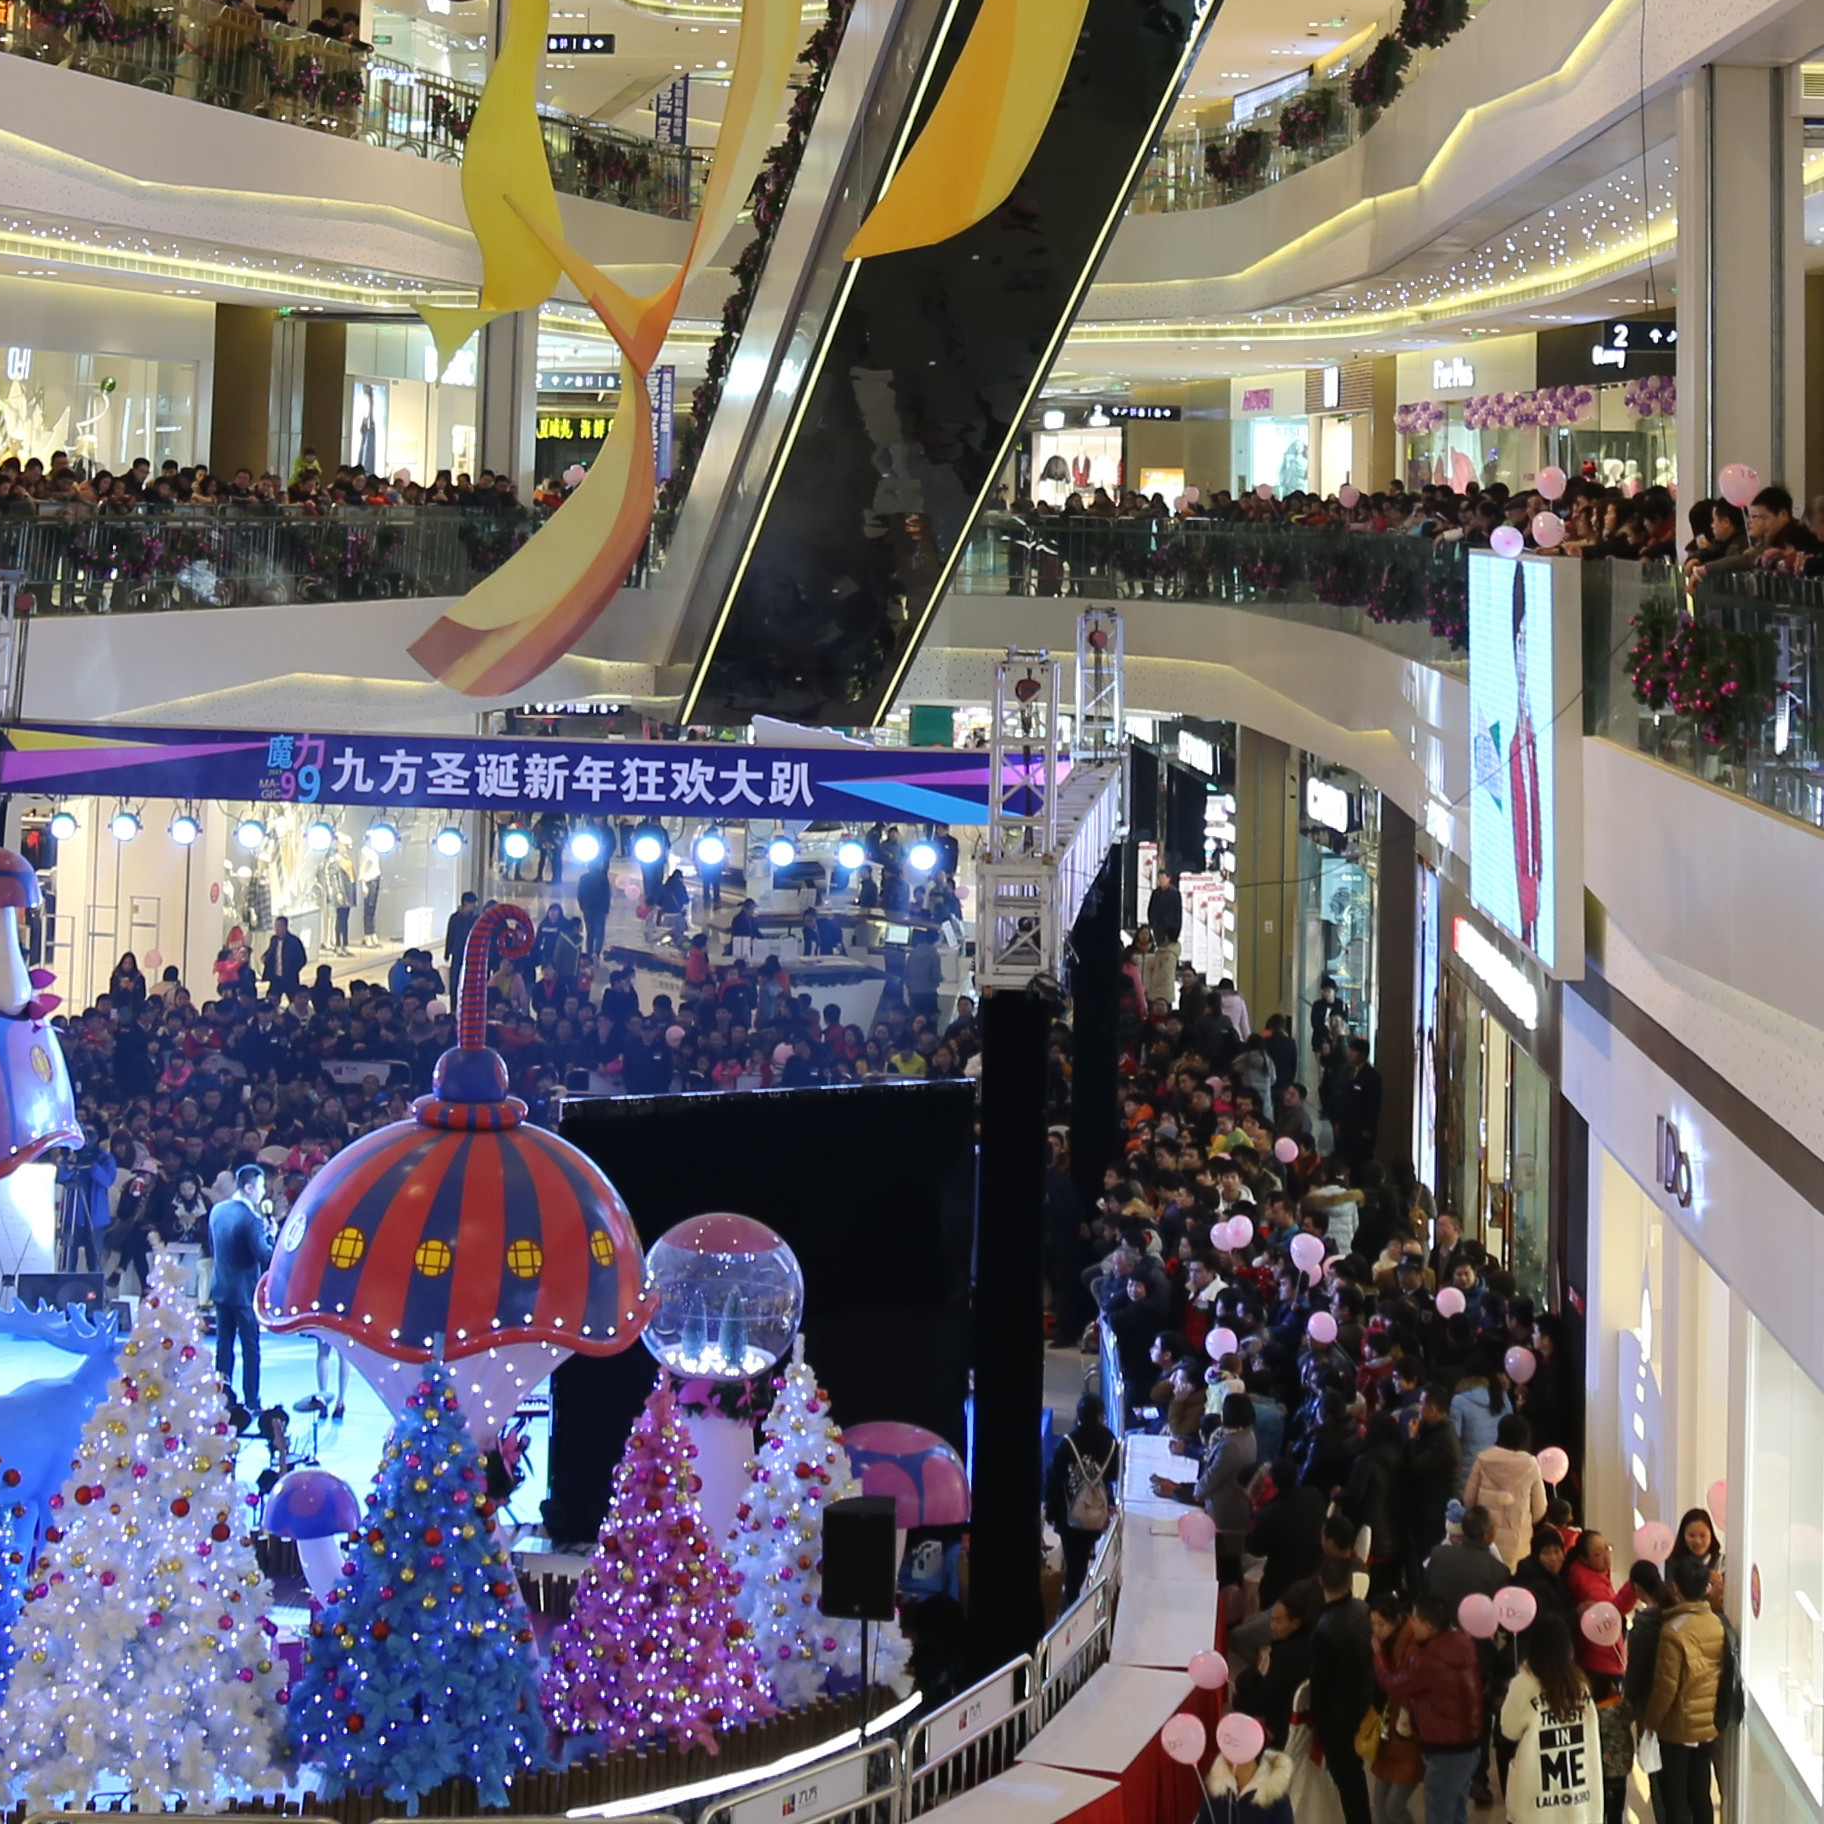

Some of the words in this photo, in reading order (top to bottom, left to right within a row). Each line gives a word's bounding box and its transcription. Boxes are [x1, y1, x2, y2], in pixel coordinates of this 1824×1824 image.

[1613, 324, 1629, 348] 2
[267, 732, 326, 770] 魔力
[331, 747, 817, 808] 九方圣诞新年狂欢大趴
[1555, 1728, 1571, 1747] IN
[1540, 1747, 1586, 1792] ME
[1536, 1794, 1560, 1809] LALA
